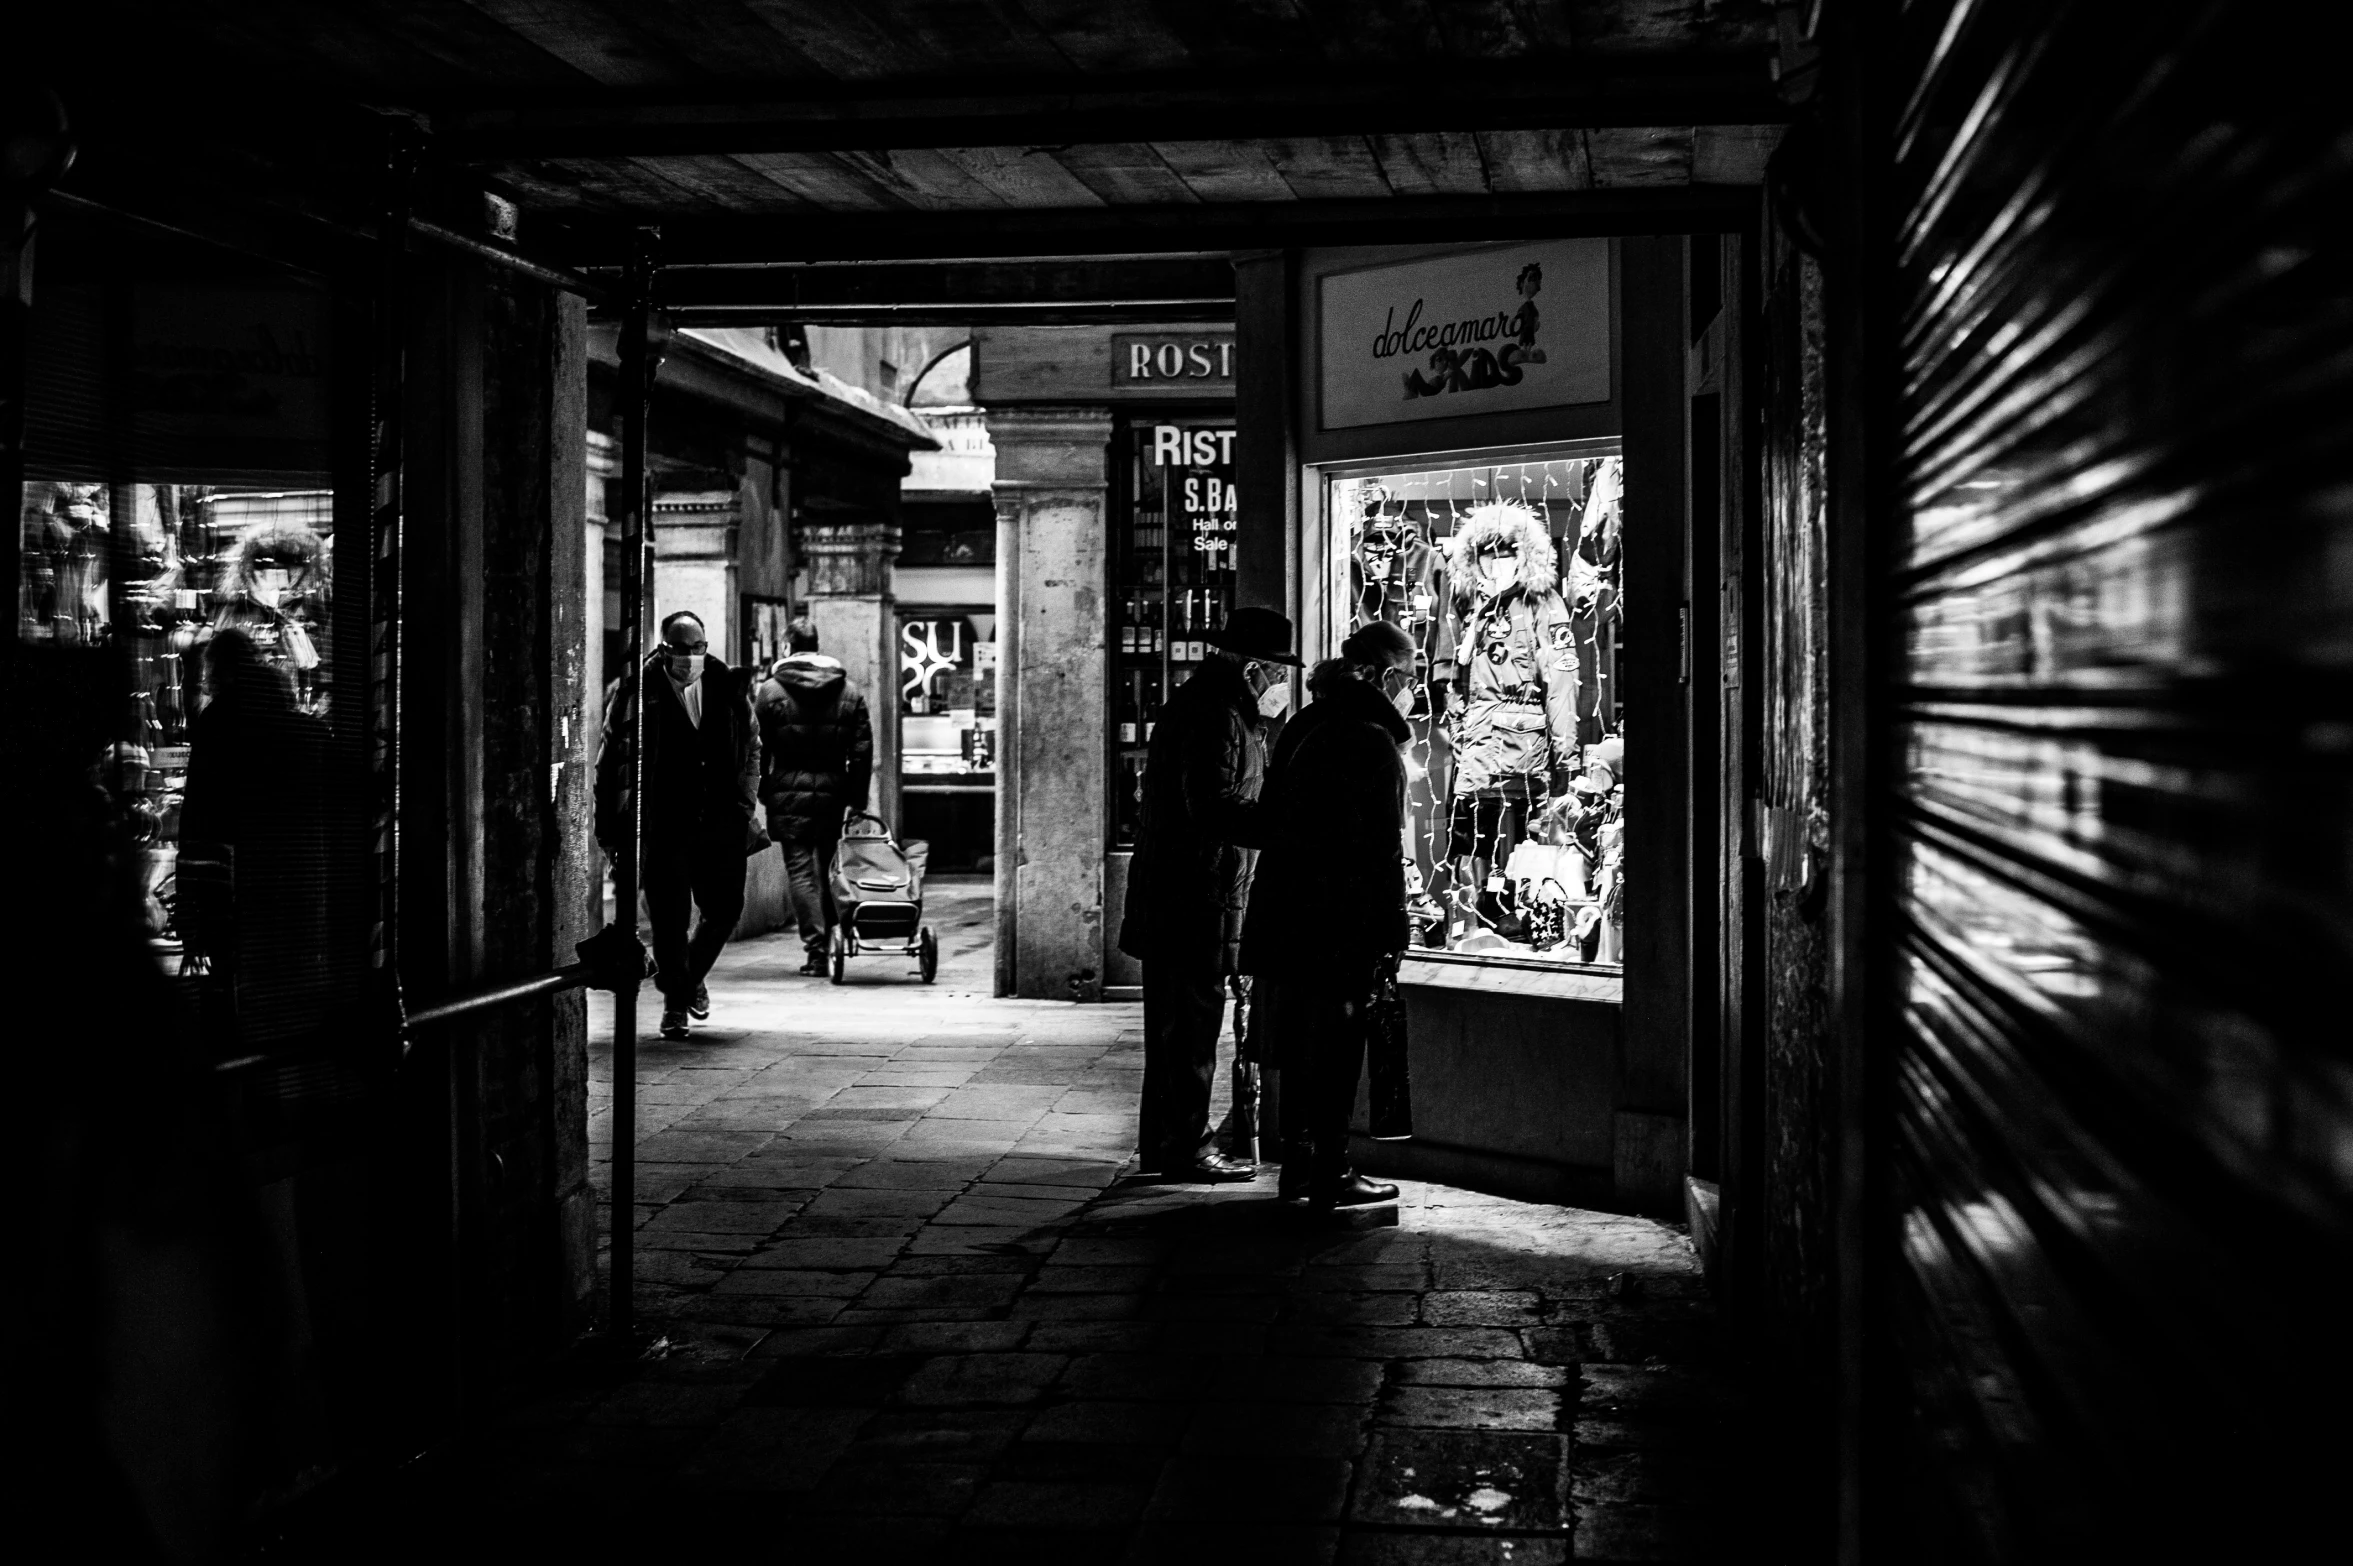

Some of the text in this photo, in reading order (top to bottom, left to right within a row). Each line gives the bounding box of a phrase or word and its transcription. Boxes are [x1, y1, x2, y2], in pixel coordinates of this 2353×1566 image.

[1372, 298, 1526, 358] dolceamaro
[1130, 343, 1237, 378] ROST
[1155, 425, 1237, 466] RIST
[1185, 477, 1237, 512] S.BA
[1193, 518, 1219, 531] Hall
[1194, 536, 1228, 551] Sale
[902, 621, 963, 662] SU
